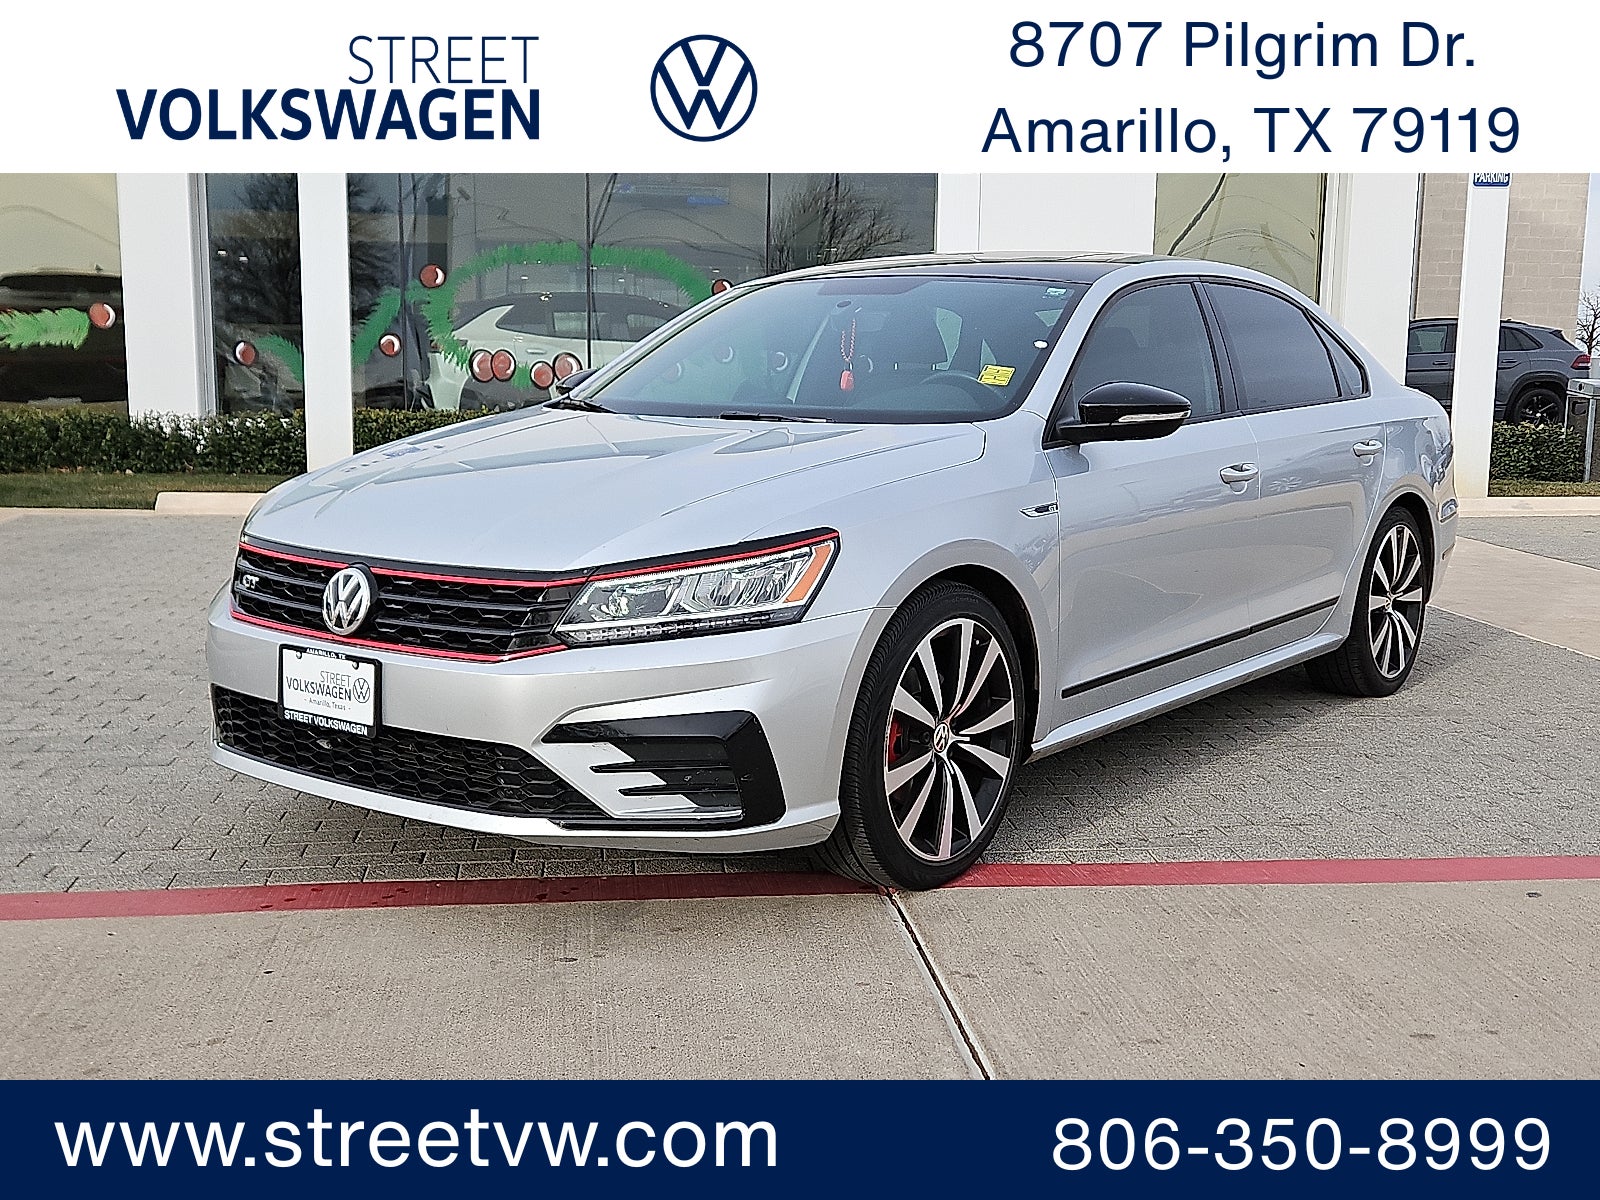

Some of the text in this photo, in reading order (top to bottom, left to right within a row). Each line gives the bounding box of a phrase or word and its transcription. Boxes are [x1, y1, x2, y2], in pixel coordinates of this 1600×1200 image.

[1474, 172, 1509, 183] PARKING
[242, 574, 260, 589] GT
[320, 670, 351, 687] STREET
[286, 676, 352, 701] VOLKSWAGEN
[284, 709, 368, 736] STREET VOLKSWAGEN
